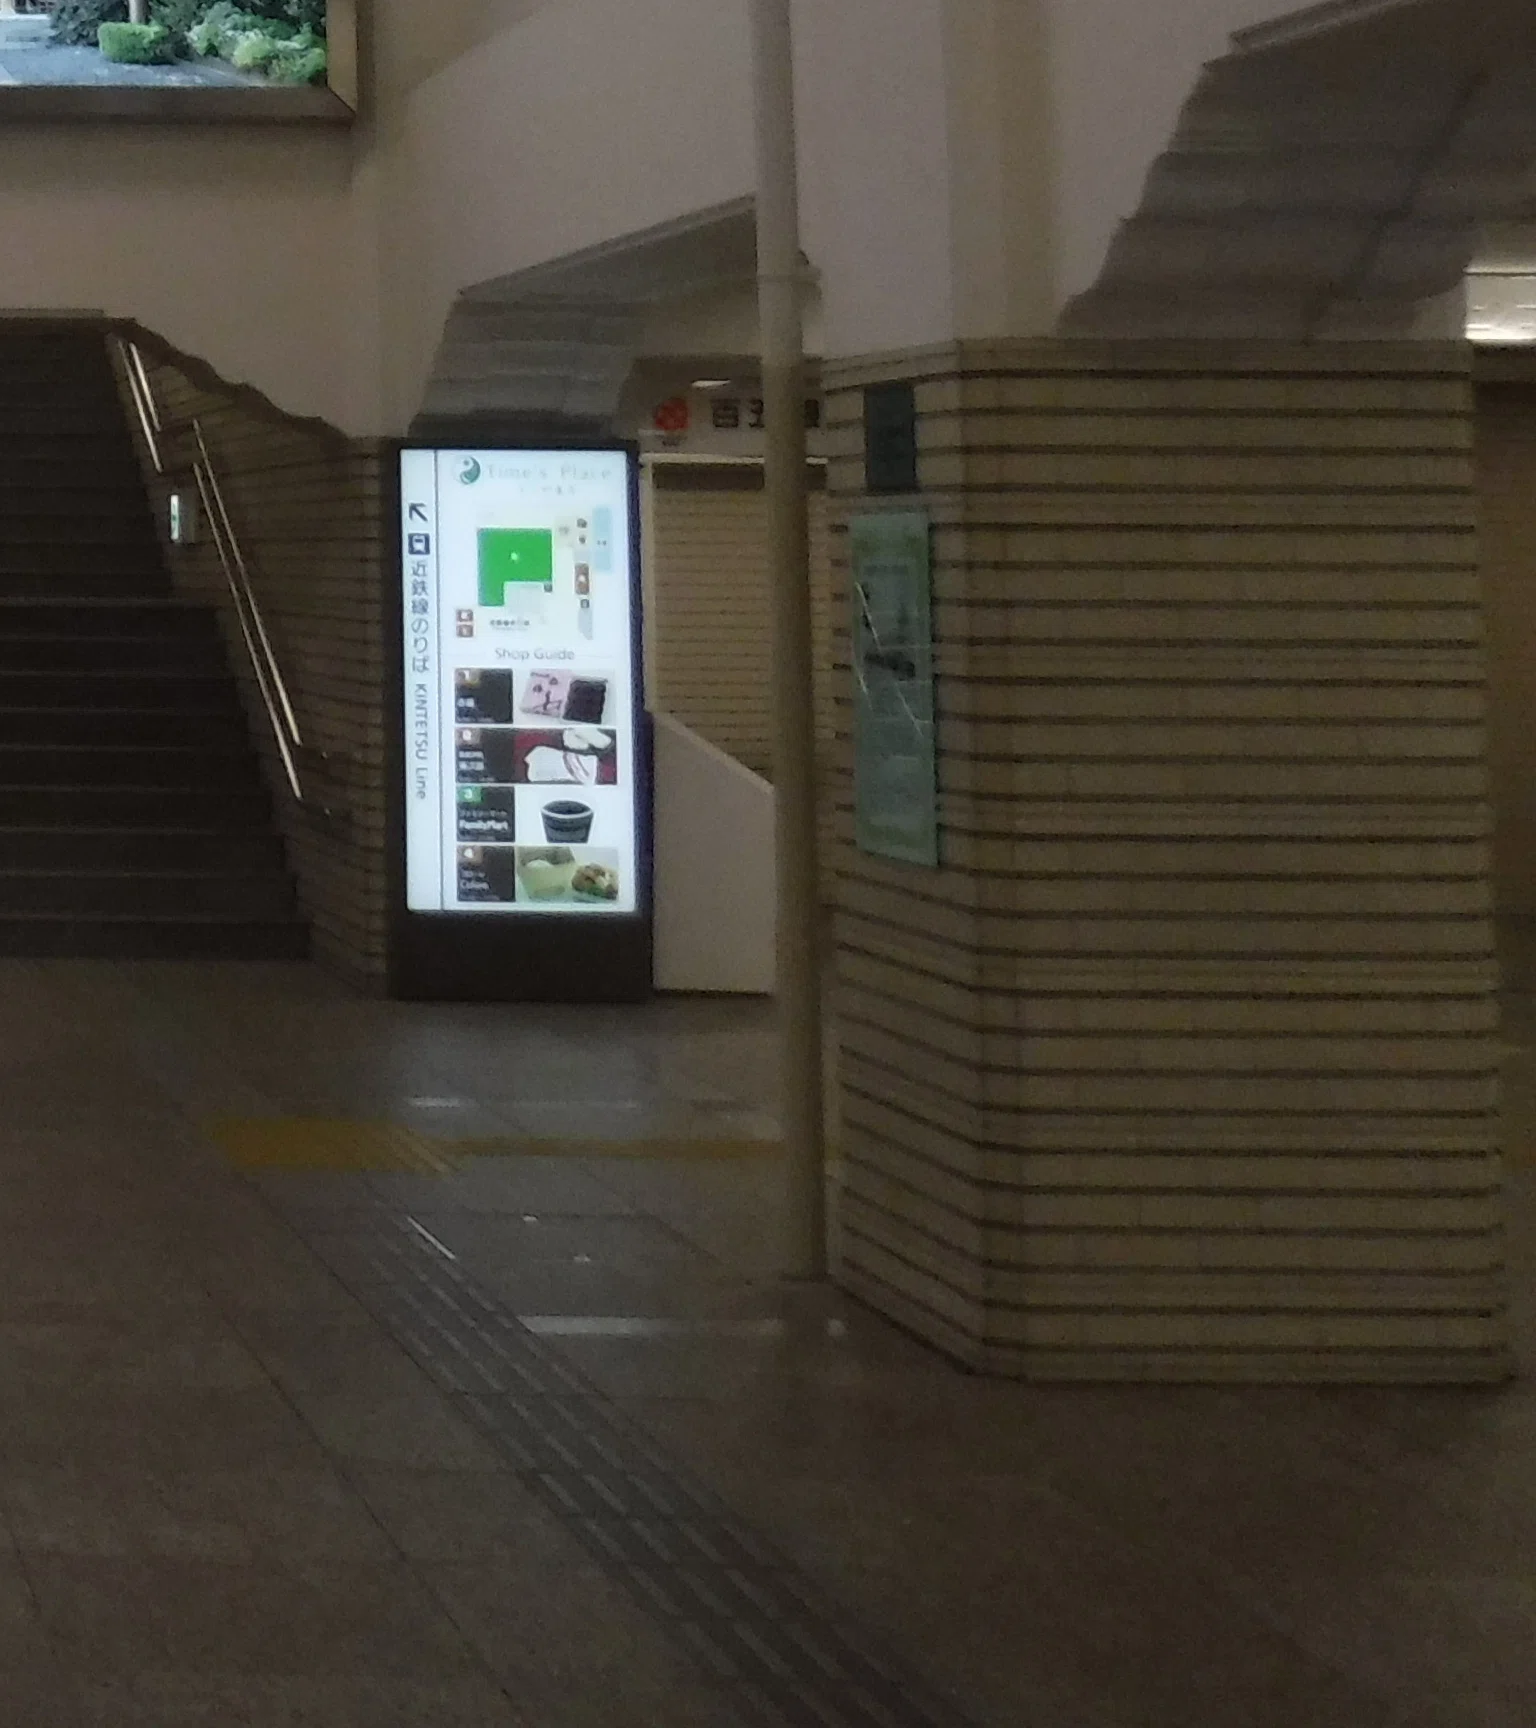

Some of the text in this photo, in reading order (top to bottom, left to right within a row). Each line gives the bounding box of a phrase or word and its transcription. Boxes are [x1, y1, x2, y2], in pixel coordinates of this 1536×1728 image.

[494, 646, 576, 662] Shop Guide
[415, 683, 428, 761] KINTETSU
[416, 767, 427, 800] Line
